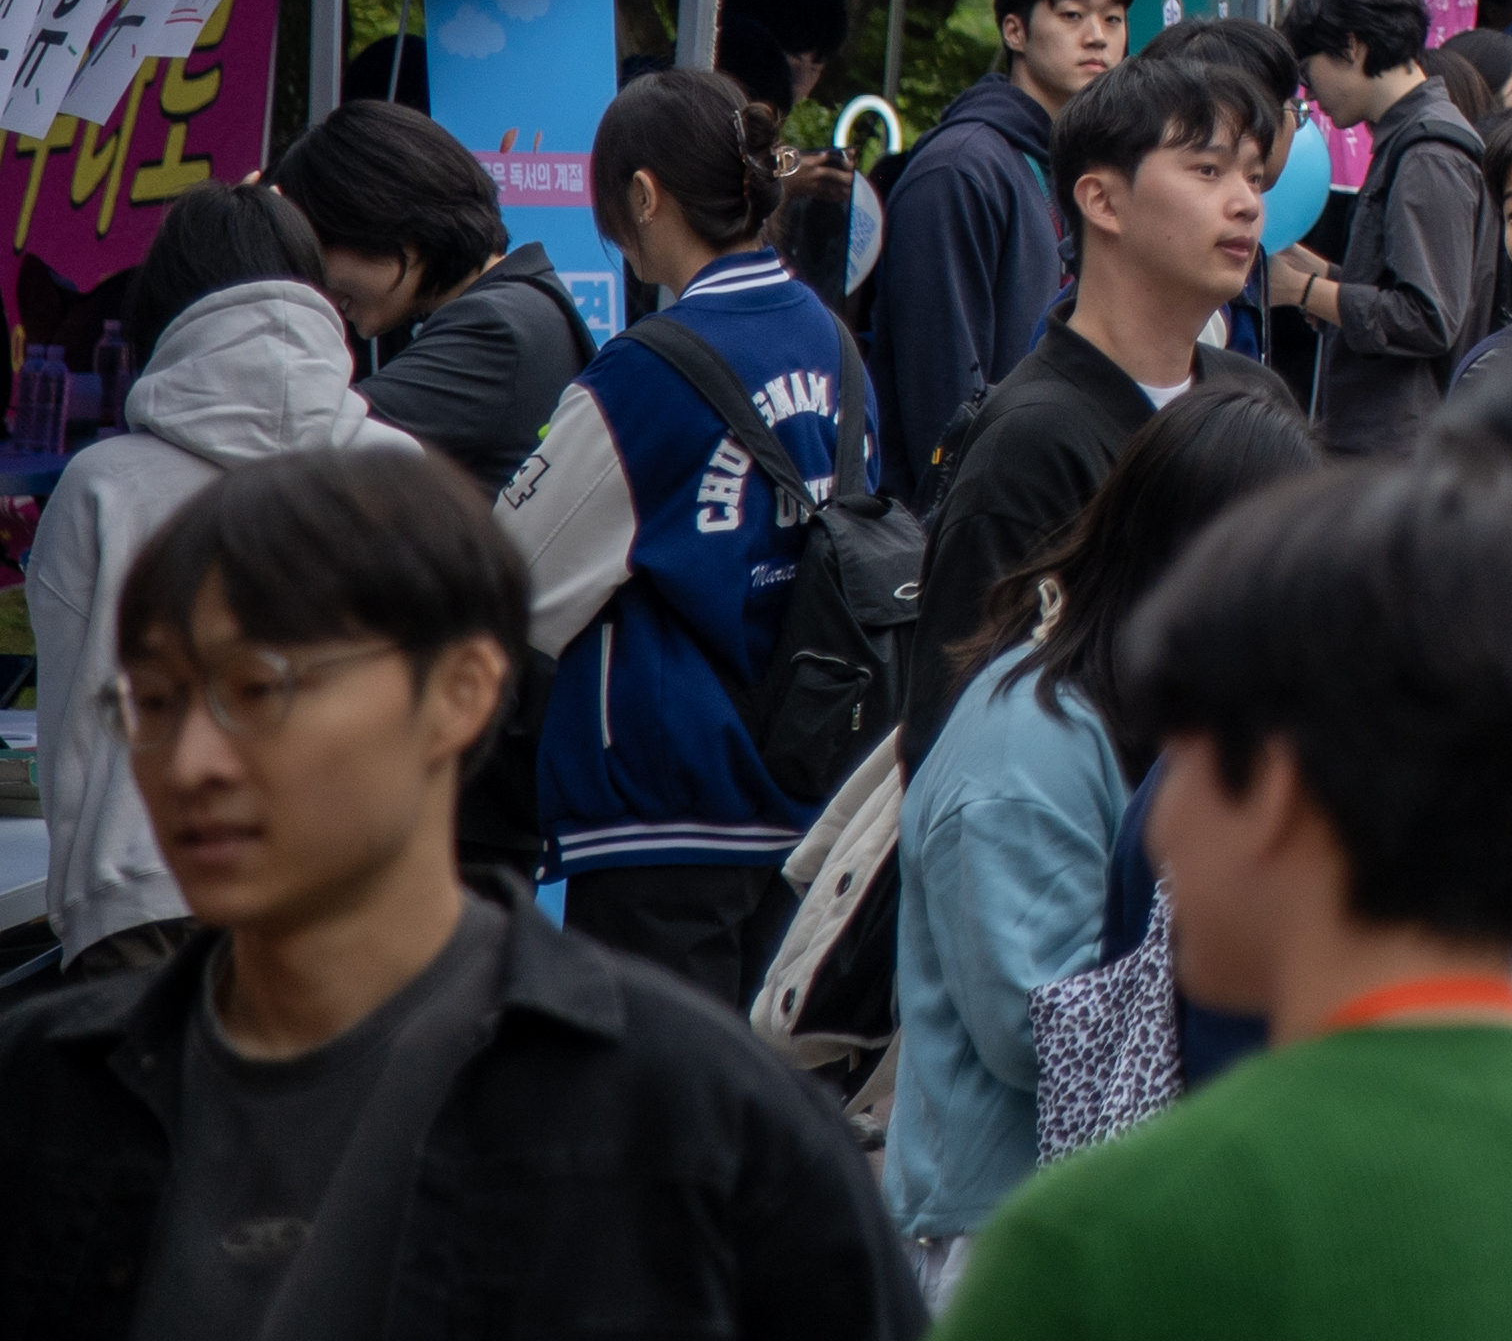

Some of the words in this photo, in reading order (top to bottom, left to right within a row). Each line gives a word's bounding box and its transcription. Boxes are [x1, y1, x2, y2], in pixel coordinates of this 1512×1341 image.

[509, 162, 551, 192] 독서의
[553, 163, 584, 193] 계절
[696, 371, 829, 534] CHUGNAM
